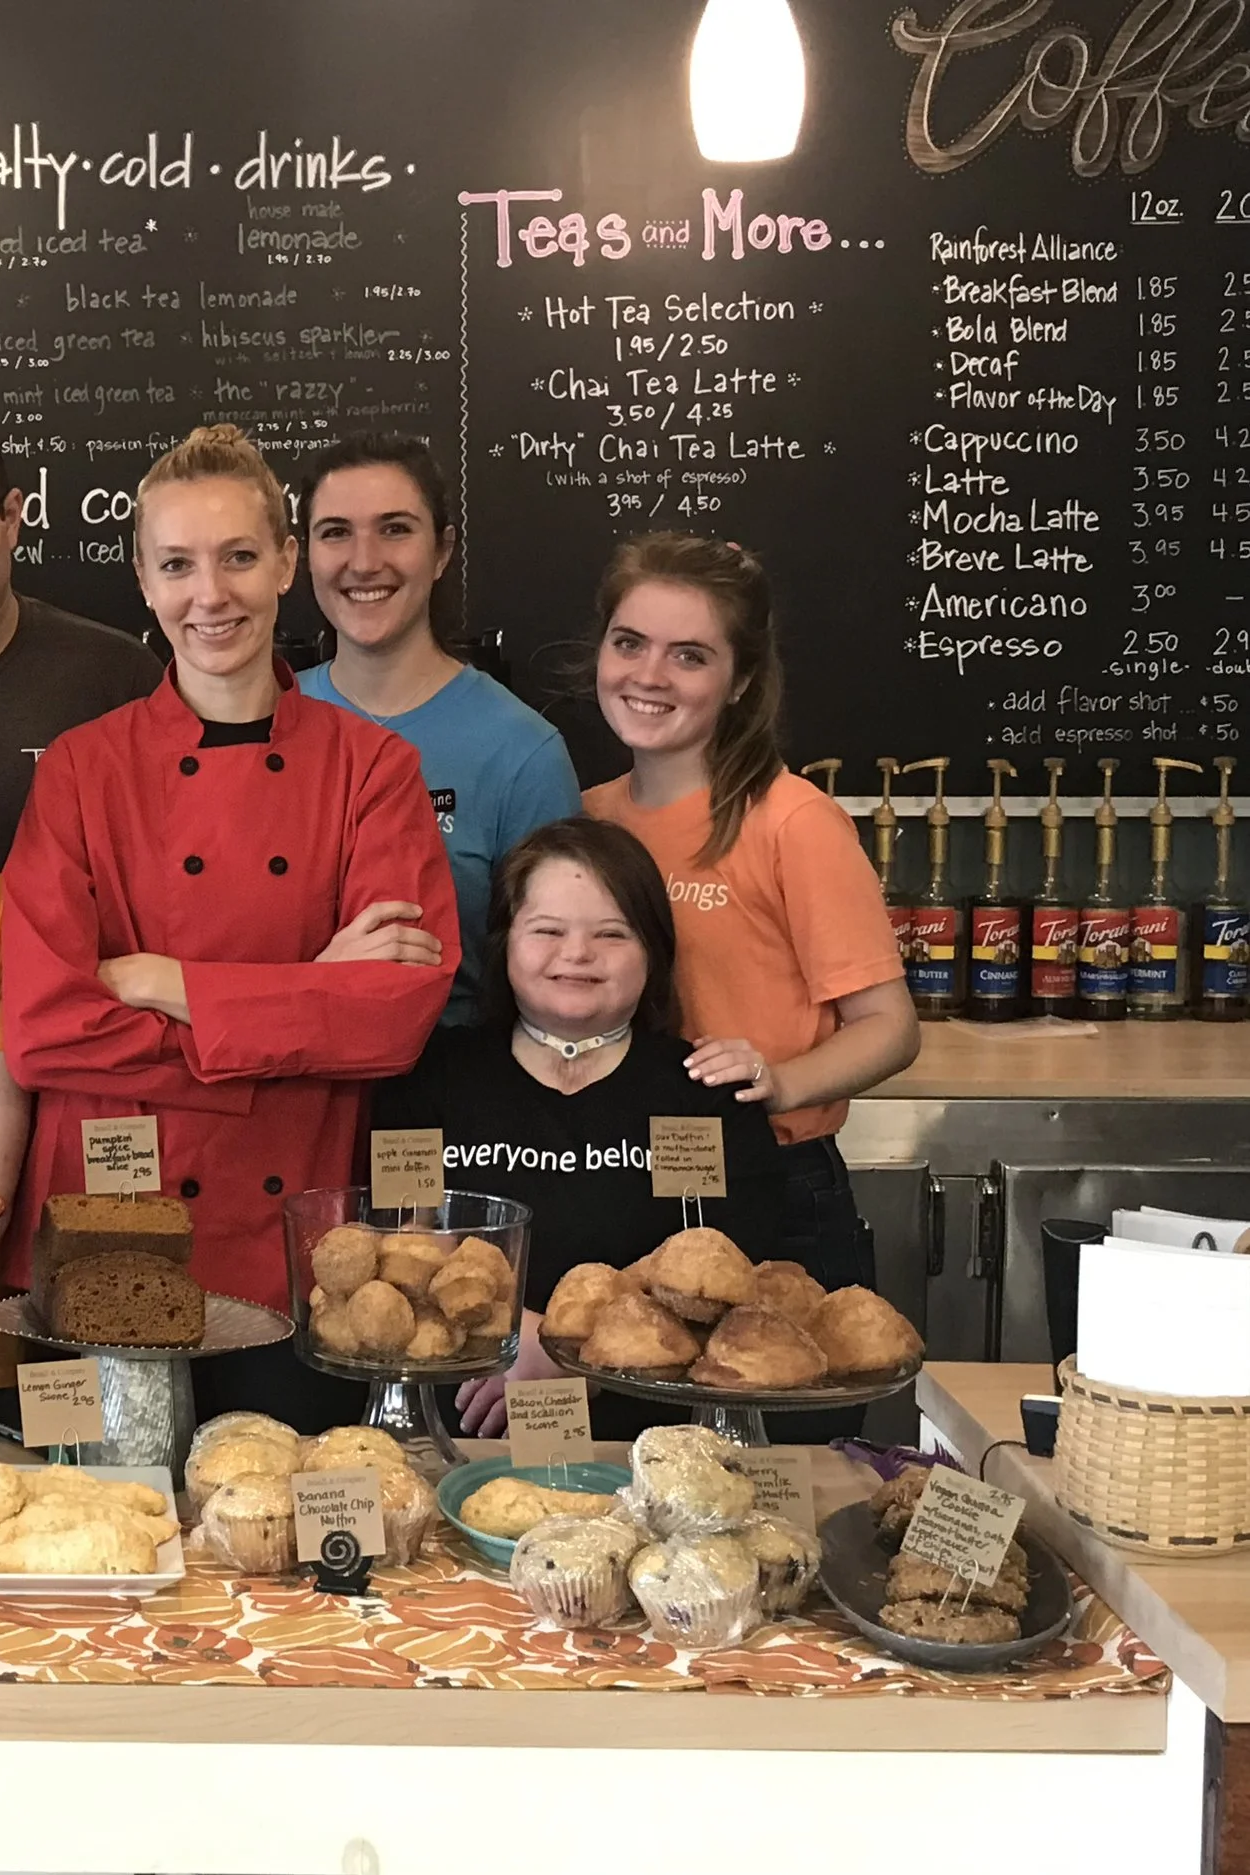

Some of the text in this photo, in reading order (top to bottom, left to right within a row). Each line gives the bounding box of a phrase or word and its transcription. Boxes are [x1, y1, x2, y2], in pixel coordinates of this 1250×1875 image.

[891, 0, 1250, 177] Coffe
[99, 131, 193, 192] cold
[235, 130, 392, 192] drinks
[247, 196, 343, 219] house made
[38, 229, 87, 253] iced
[98, 229, 148, 254] tea
[238, 221, 362, 254] lemonade
[458, 188, 632, 268] Teas
[642, 219, 690, 246] and
[930, 226, 1118, 264] Rainforest Alliance
[66, 281, 297, 312] black tea lemonade
[943, 274, 1178, 309] Breakfast Blend 1.85
[544, 291, 795, 330] Hot Tea Selection
[51, 334, 111, 362] green
[120, 328, 155, 349] tea
[201, 320, 400, 352] hibiscus sparkler
[947, 314, 1068, 343] Bold Blend
[951, 351, 1020, 380] Decaf
[214, 377, 253, 403] the
[548, 367, 777, 400] Chai Tea Latte
[950, 382, 1179, 424] Flavor of the Day 1.85
[86, 439, 142, 462] passion
[598, 433, 659, 463] Chai
[669, 433, 716, 460] Tea
[729, 432, 806, 460] Latte
[924, 423, 1185, 463] Cappuccino 3.50
[547, 468, 747, 495] (with a shot of espresso)
[925, 464, 1190, 495] Latte 3.50
[922, 498, 1184, 534] Mocha Latte 3.95
[918, 538, 1093, 573] Breve Latte
[920, 583, 1087, 621] Americano
[918, 630, 1178, 675] Espresso 2.50
[1003, 685, 1171, 714] add flavor shot
[666, 872, 728, 911] longs
[978, 919, 1019, 948] Tora
[442, 1139, 652, 1172] everyone belo
[21, 1383, 50, 1392] Lemon
[297, 1489, 346, 1503] Banana
[299, 1498, 375, 1516] Chocolate Chip
